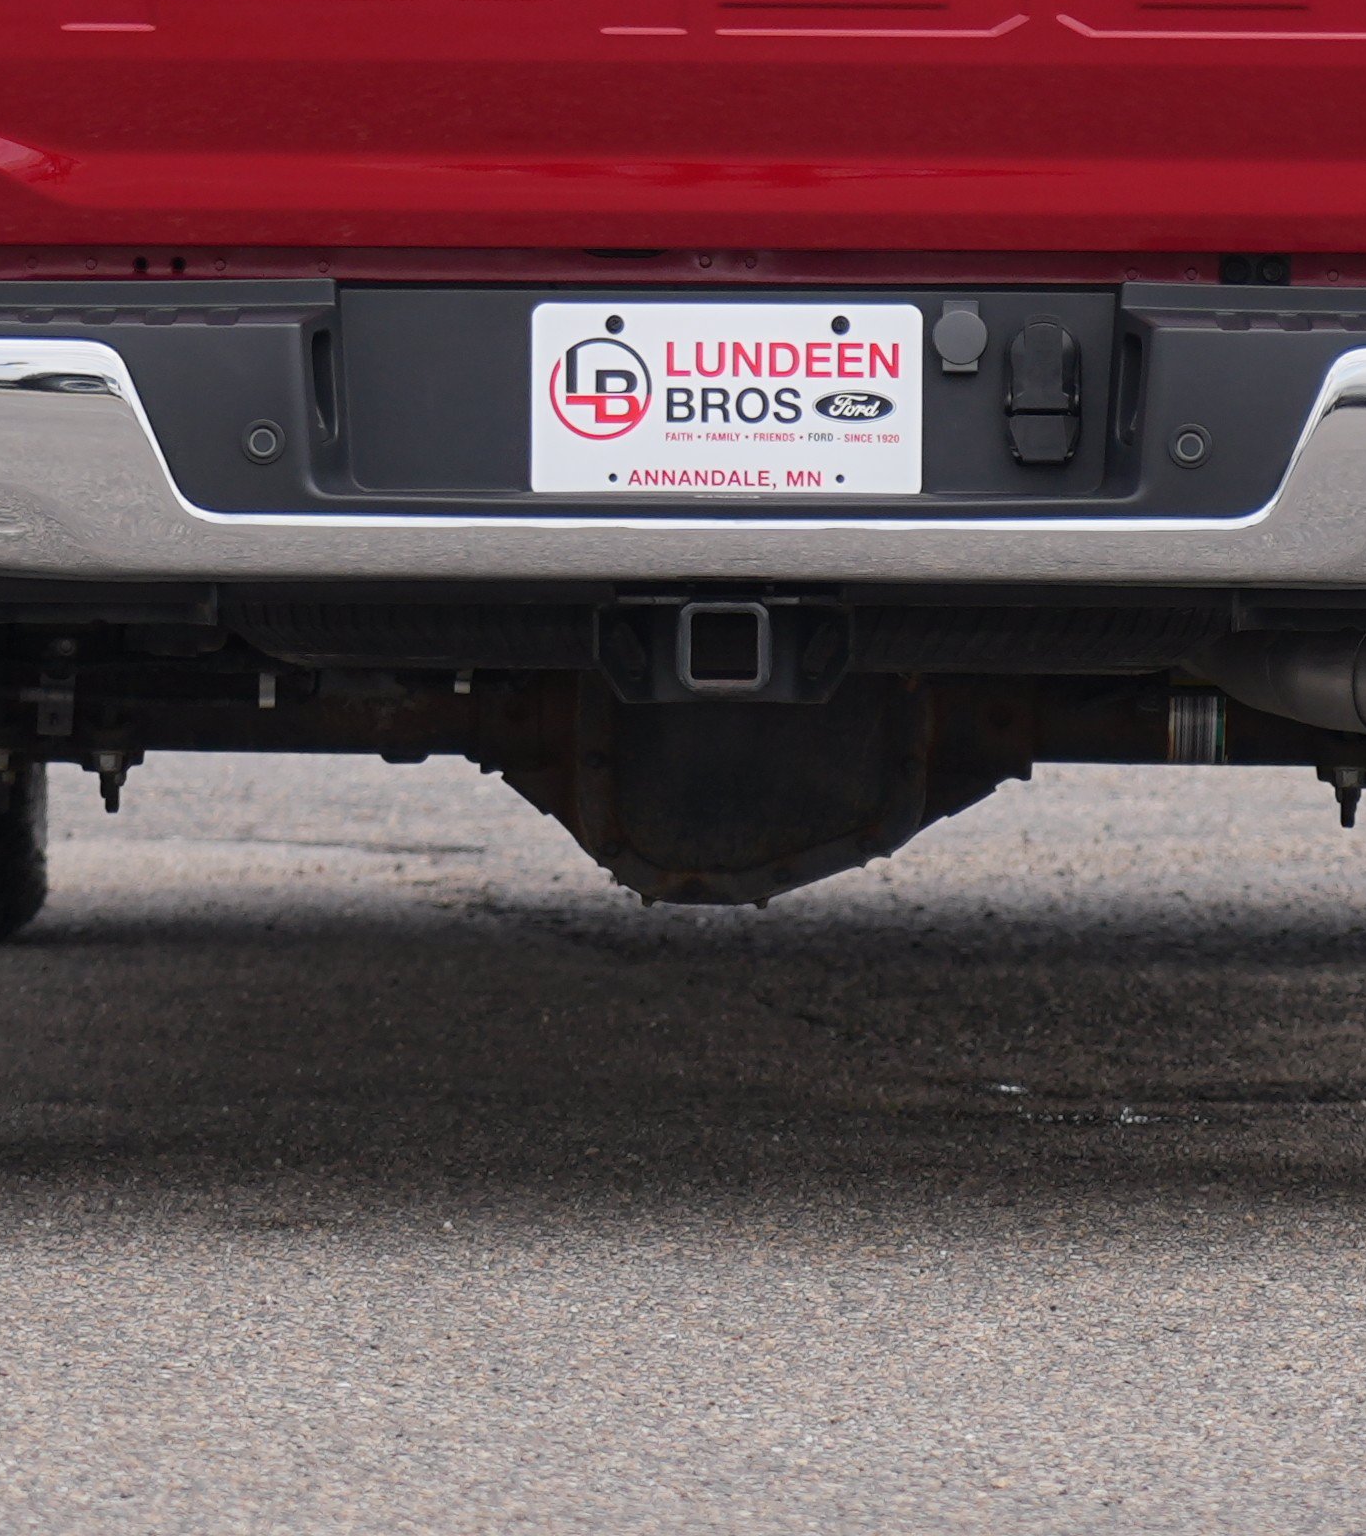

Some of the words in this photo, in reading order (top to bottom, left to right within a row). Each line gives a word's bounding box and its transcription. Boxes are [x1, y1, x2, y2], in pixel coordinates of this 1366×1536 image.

[665, 341, 900, 379] LUNDEEN
[665, 387, 803, 424] BROS
[665, 432, 693, 442] FAITH
[705, 432, 740, 442] FAMILY
[753, 433, 796, 442] FRIENDS
[807, 433, 834, 442] FORD
[843, 433, 873, 443] SINCE
[876, 434, 900, 443] 1920
[627, 470, 778, 490] ANNANDALE,
[785, 470, 823, 487] MN
